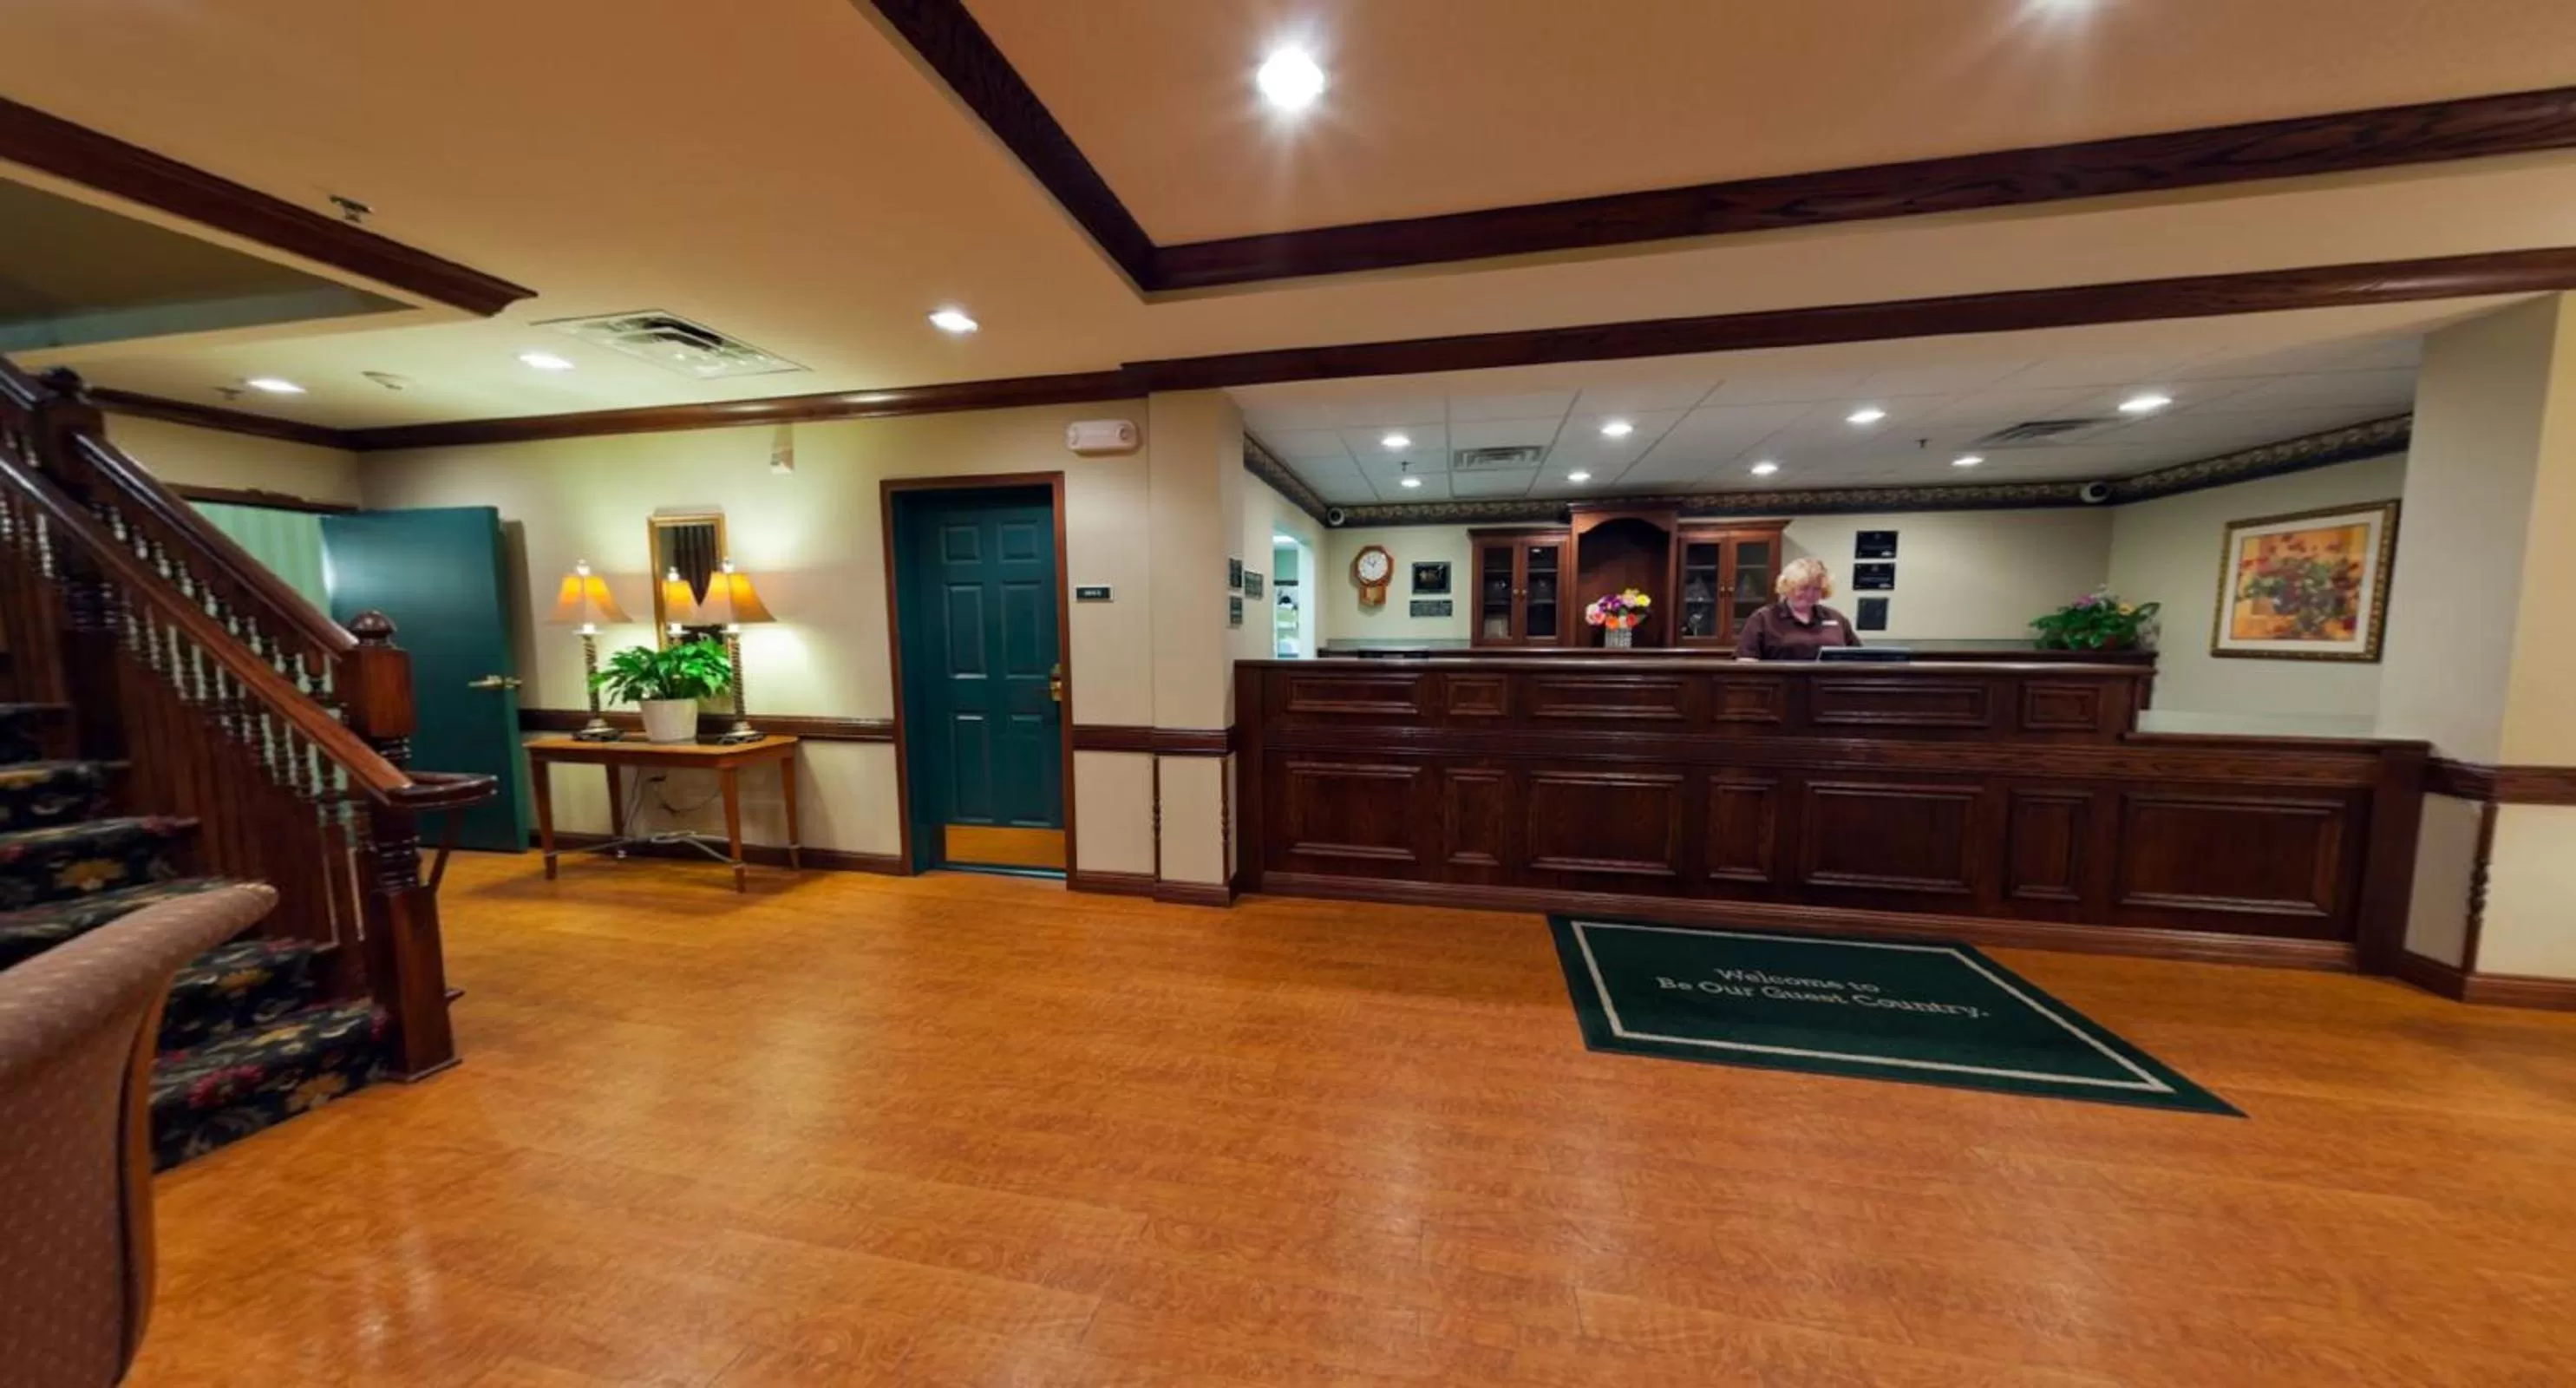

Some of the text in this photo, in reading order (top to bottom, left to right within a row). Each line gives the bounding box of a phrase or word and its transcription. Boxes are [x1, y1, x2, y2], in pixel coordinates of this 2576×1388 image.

[1713, 967, 1880, 992] Welcome to
[1655, 976, 1991, 1018] Be Our Guest Country.
